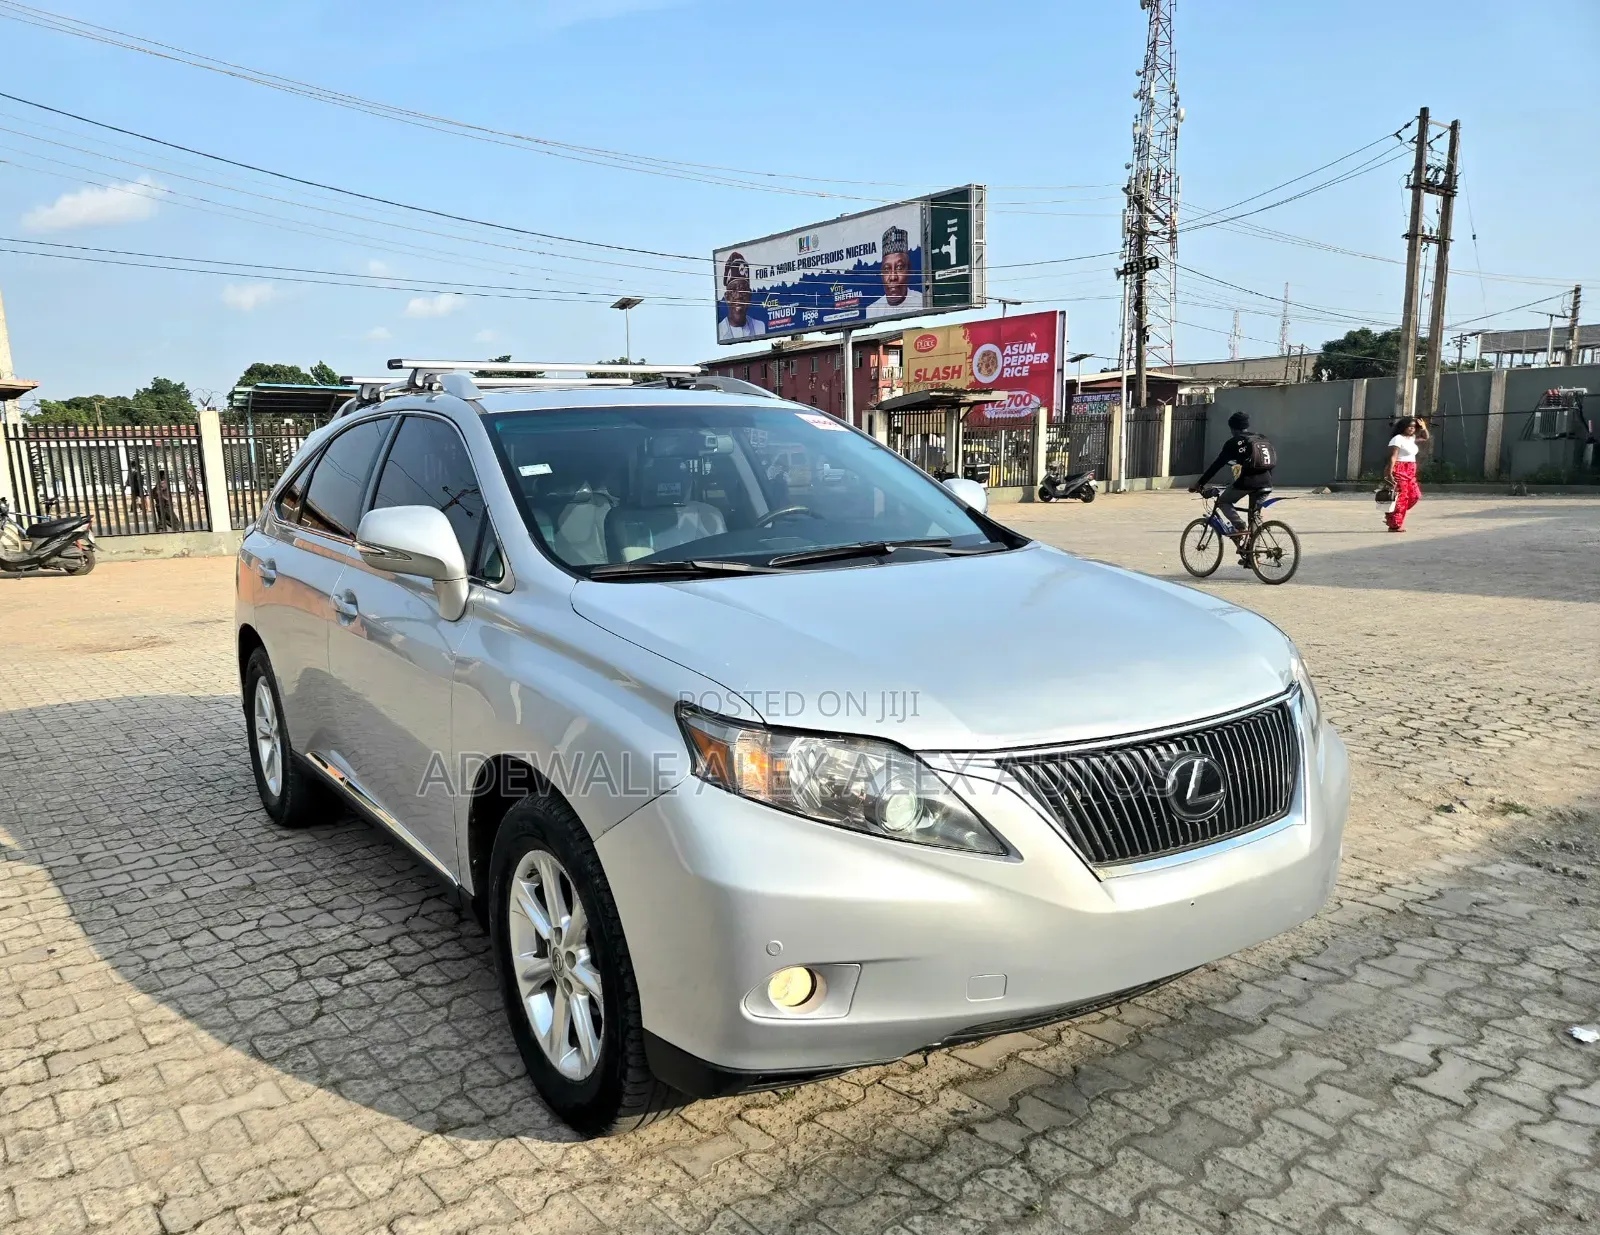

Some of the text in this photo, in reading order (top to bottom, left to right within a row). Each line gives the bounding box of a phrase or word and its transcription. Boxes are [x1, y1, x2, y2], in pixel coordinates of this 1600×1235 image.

[755, 242, 877, 279] FOR A MORE PROSPEROUS NIGERIA
[767, 307, 796, 320] TINUBU
[1003, 342, 1036, 355] ASUN
[1003, 352, 1049, 366] PEPPER
[914, 365, 963, 382] SLASH
[1003, 366, 1030, 378] RICE
